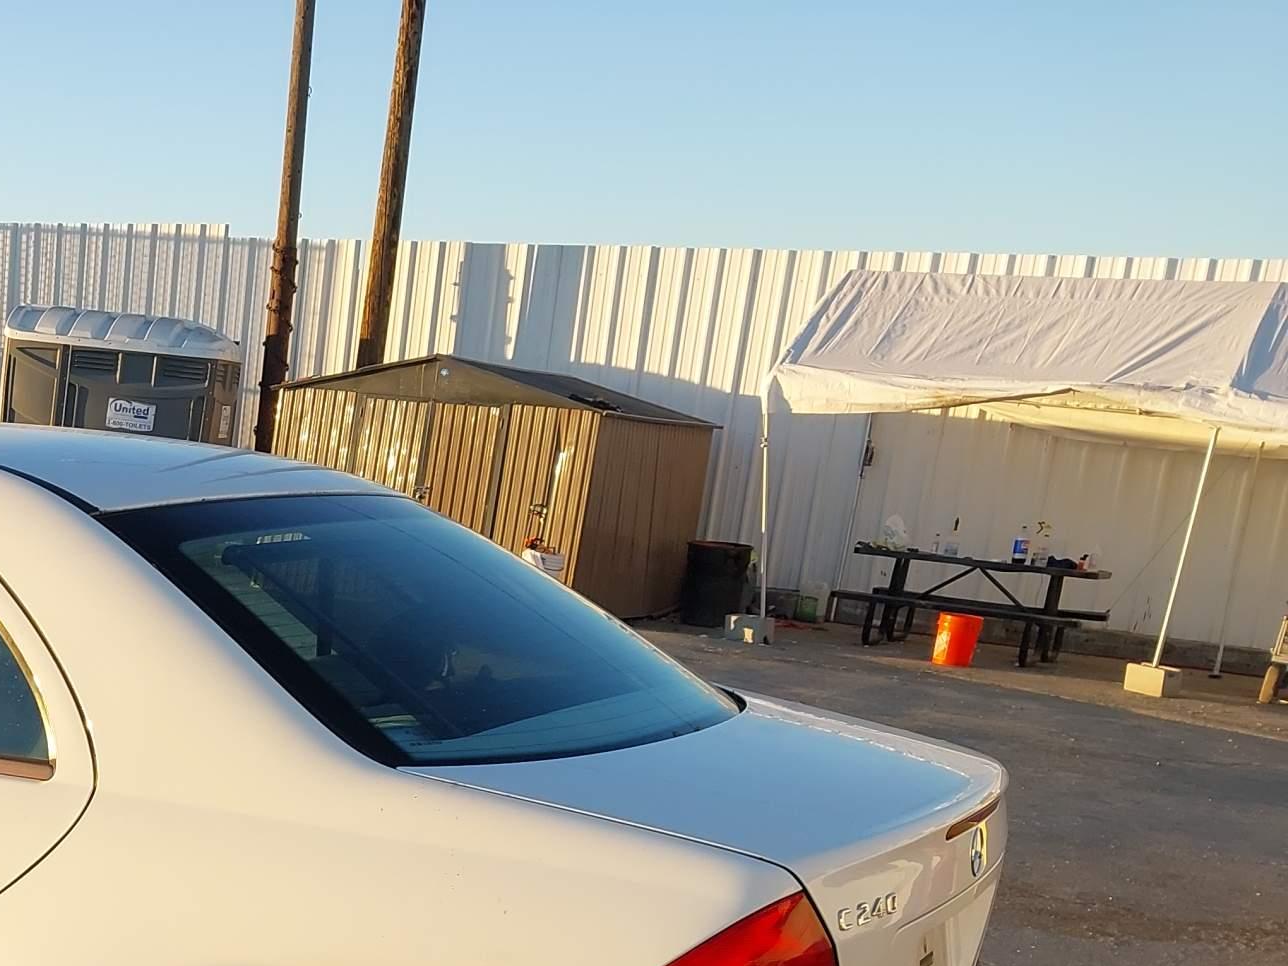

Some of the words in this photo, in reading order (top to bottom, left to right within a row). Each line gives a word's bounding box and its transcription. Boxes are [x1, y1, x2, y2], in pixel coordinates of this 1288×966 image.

[114, 402, 150, 416] United
[837, 908, 854, 931] C
[856, 893, 897, 926] 240
